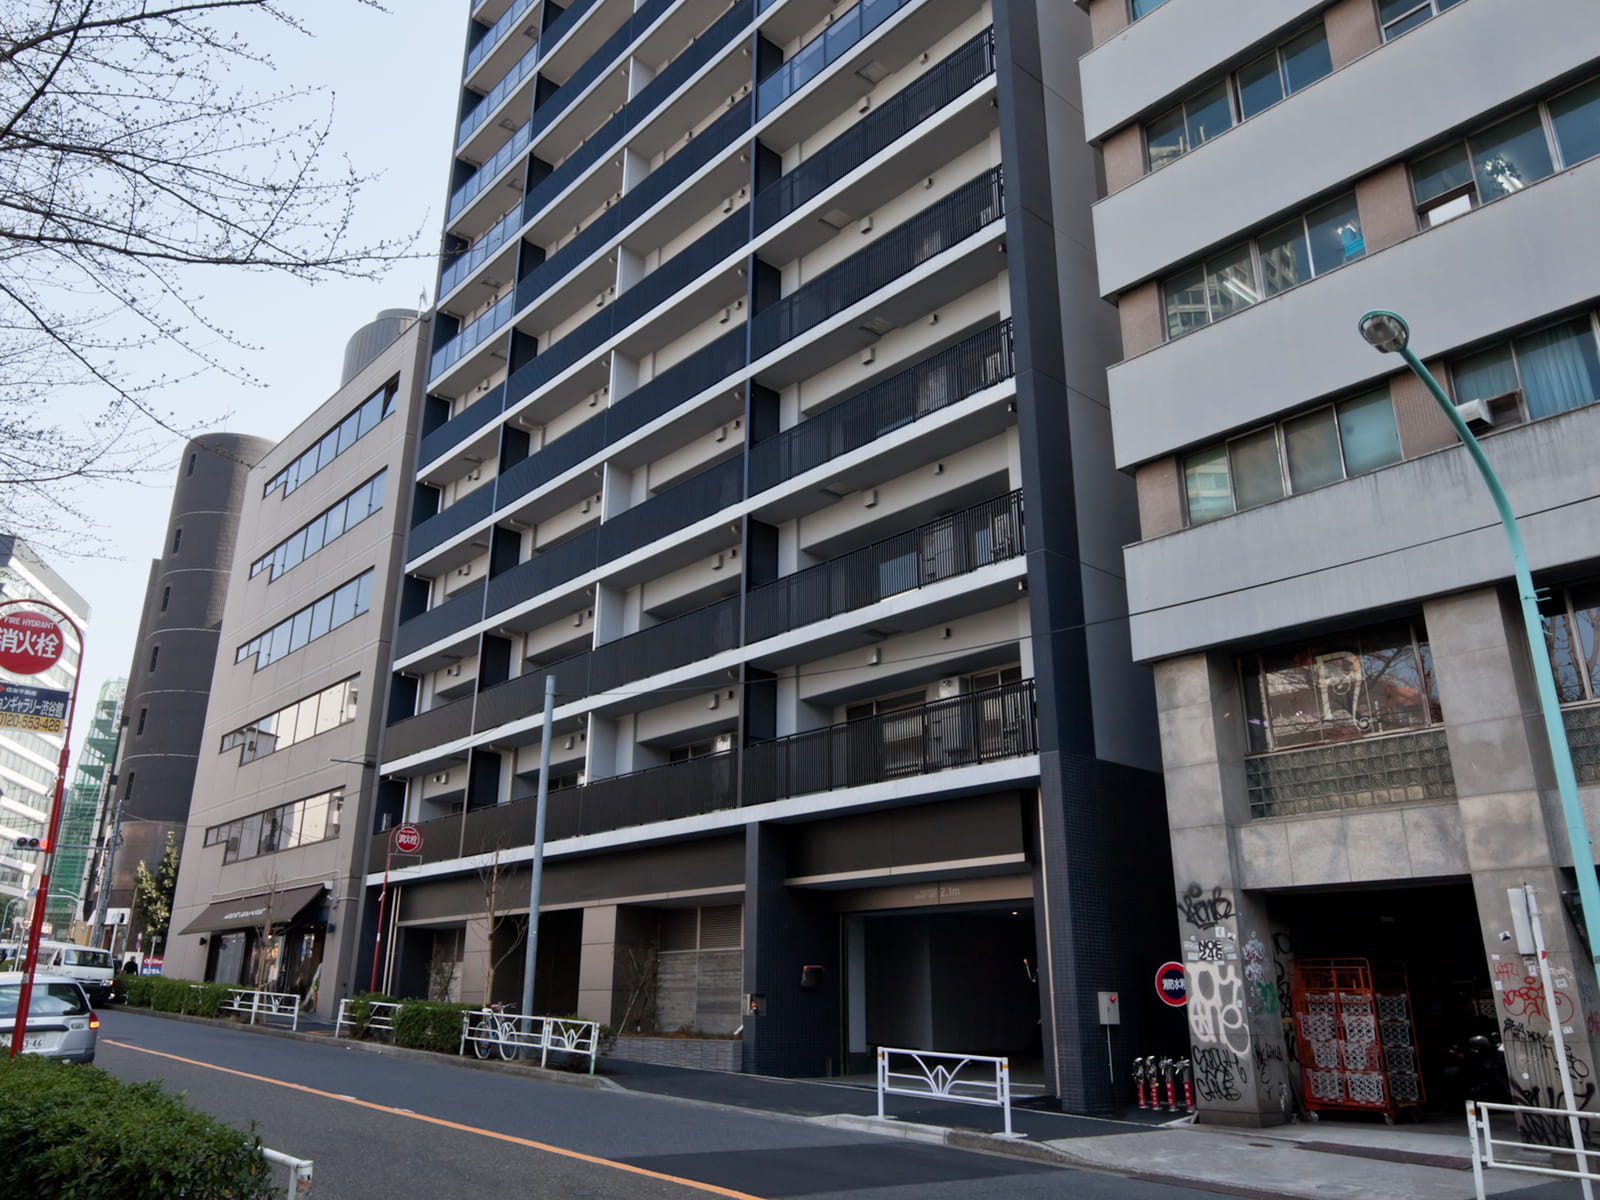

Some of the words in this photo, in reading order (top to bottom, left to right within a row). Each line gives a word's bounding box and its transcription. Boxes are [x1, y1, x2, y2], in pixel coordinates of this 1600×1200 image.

[4, 616, 20, 625] FIRE
[22, 618, 55, 629] HYDRANT
[0, 628, 59, 658] 消火栓
[1200, 949, 1223, 960] 246
